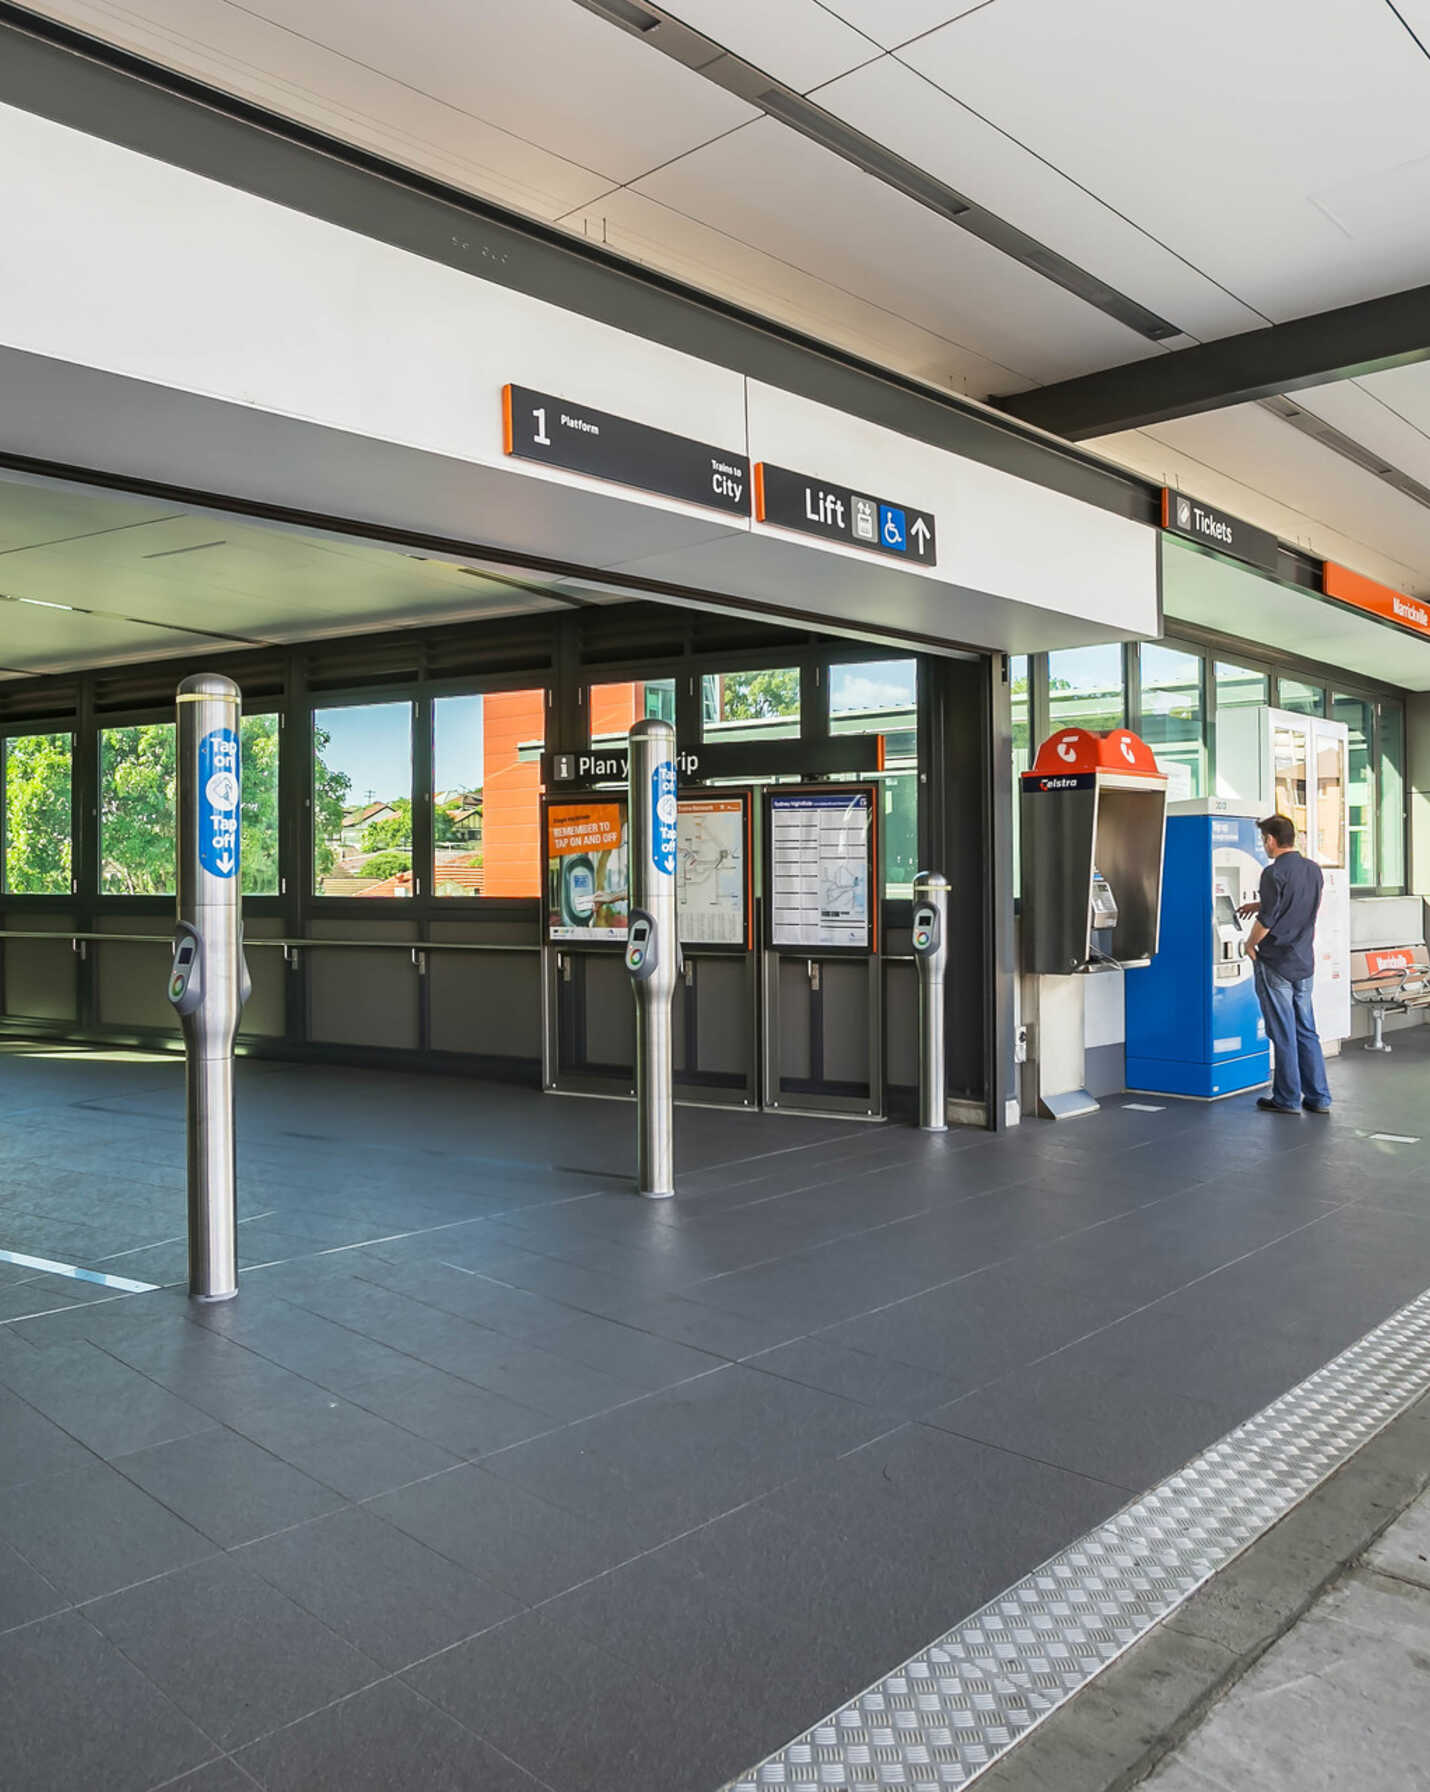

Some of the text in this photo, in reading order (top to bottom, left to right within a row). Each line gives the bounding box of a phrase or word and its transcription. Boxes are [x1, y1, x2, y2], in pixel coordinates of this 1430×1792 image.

[532, 408, 551, 446] 1
[560, 414, 600, 435] Platform
[711, 459, 742, 477] Trains to
[712, 474, 743, 502] City
[805, 487, 845, 529] Lift
[1193, 508, 1232, 544] Tickets
[210, 737, 237, 755] Tap
[214, 755, 234, 767] on
[579, 756, 617, 775] Plan
[1040, 778, 1078, 792] Telstra
[210, 815, 237, 833] Tap
[553, 821, 611, 837] REMEMBER TO
[212, 834, 235, 848] off
[555, 832, 618, 849] TAP ON AND OFF
